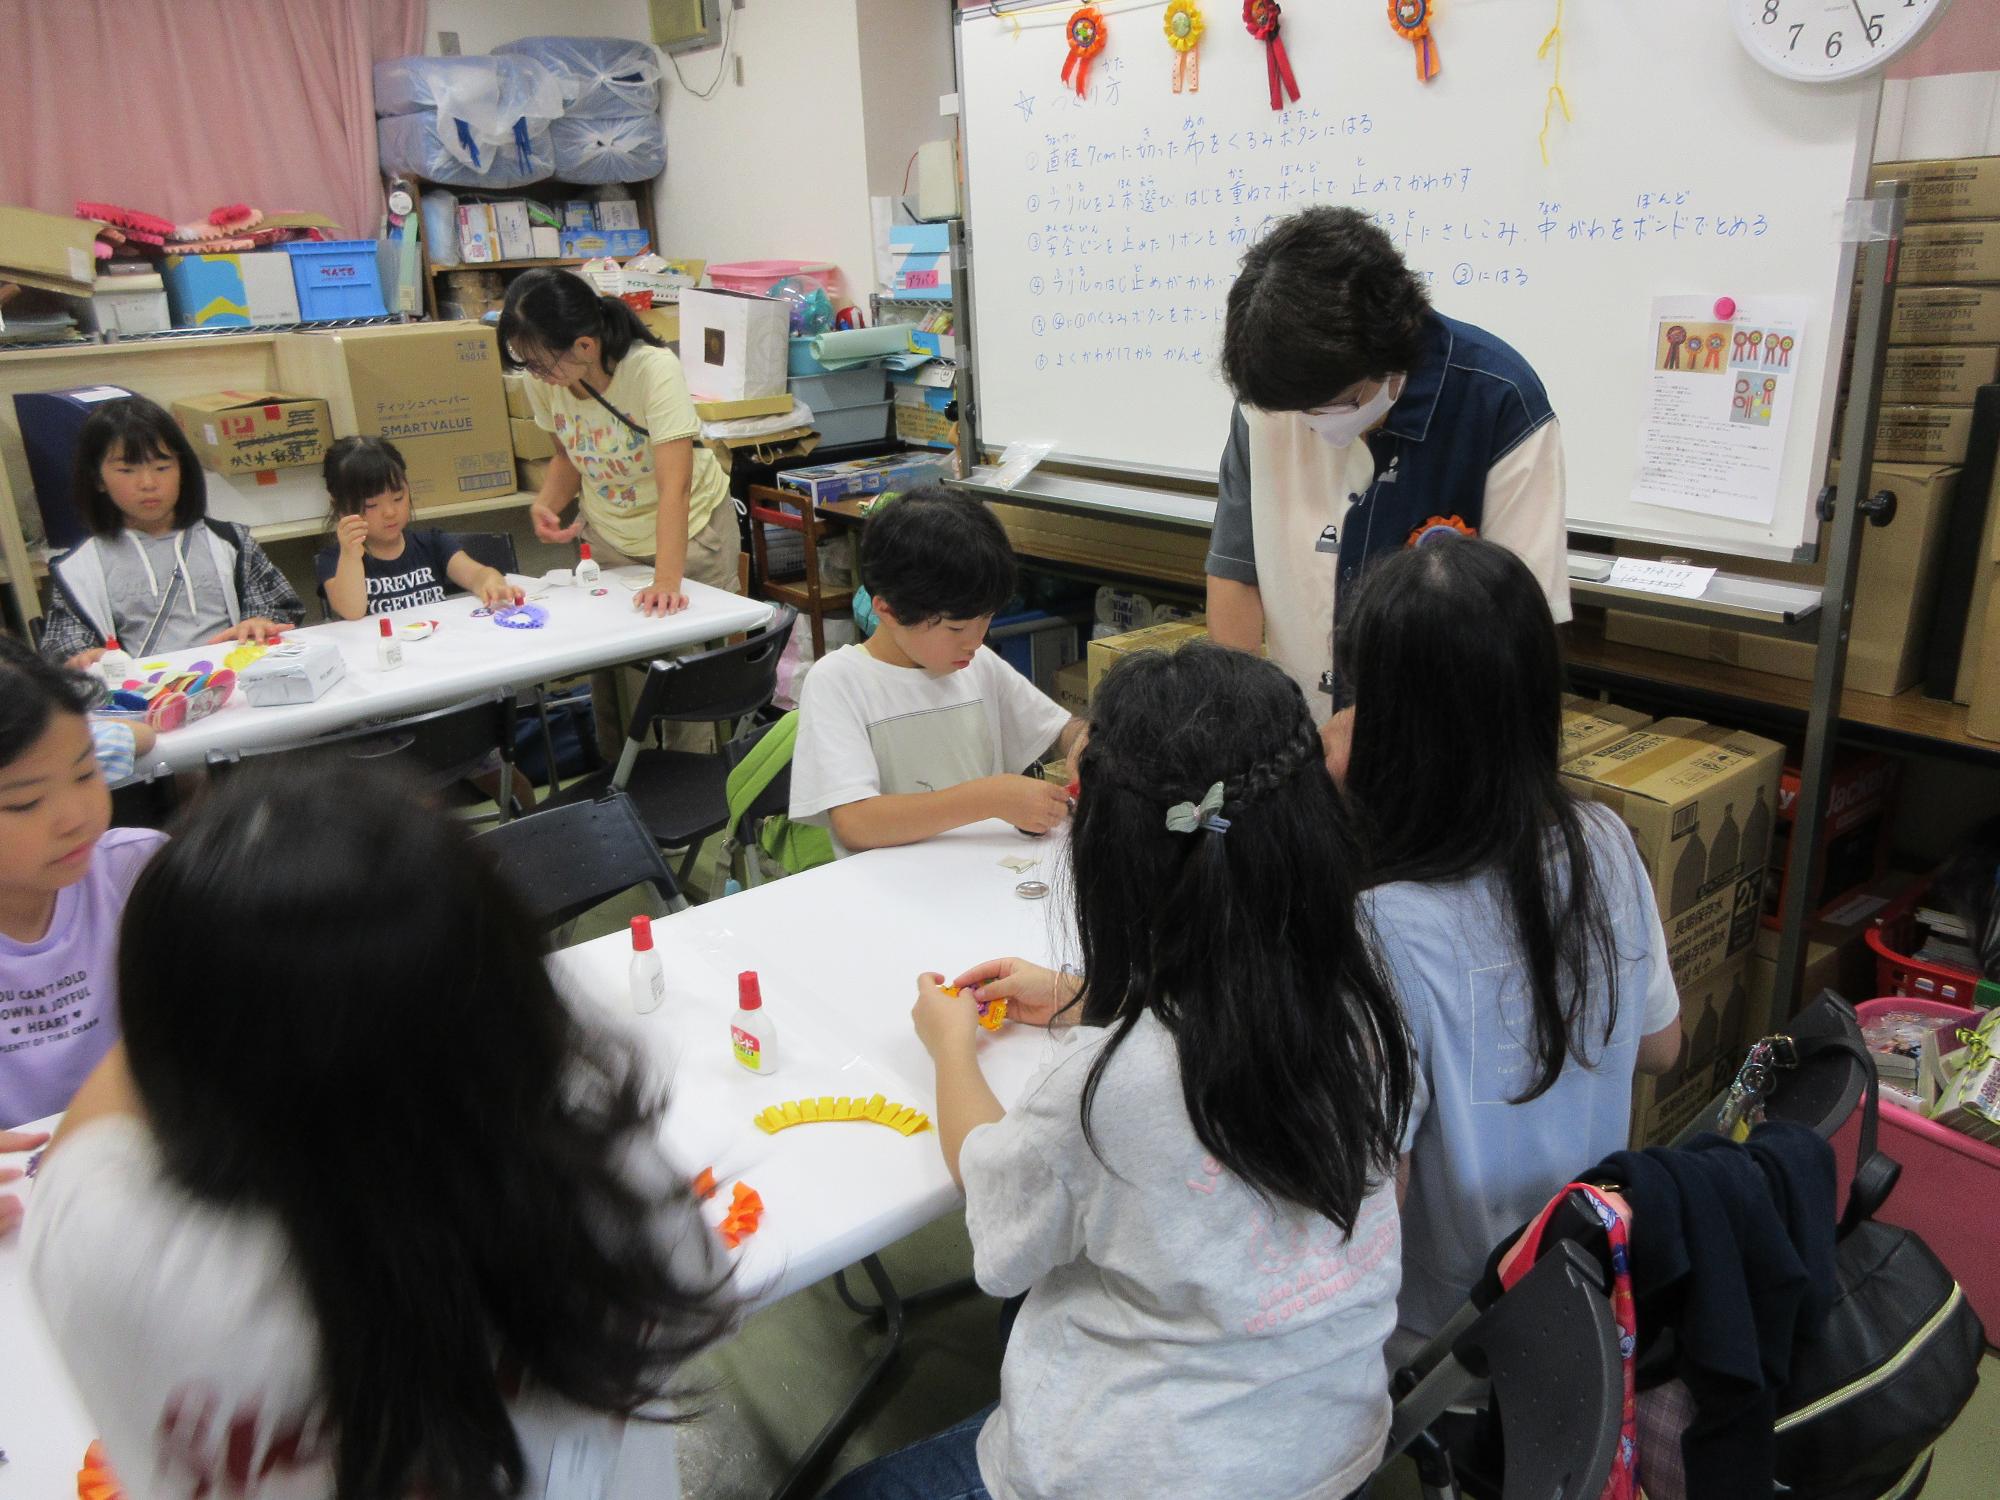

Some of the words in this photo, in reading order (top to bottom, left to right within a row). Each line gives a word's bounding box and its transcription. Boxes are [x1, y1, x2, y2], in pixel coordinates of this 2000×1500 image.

[1761, 0, 1780, 25] 8
[1788, 23, 1805, 51] 7
[1866, 14, 1886, 42] 5
[1825, 31, 1844, 59] 6
[377, 395, 471, 414] ティッシュペーパー
[366, 566, 435, 596] OREVER
[19, 984, 55, 1000] CAN'T
[57, 970, 87, 987] HOLD
[38, 1005, 48, 1014] A
[52, 987, 91, 1012] JOYFUL
[27, 1015, 70, 1034] HEART
